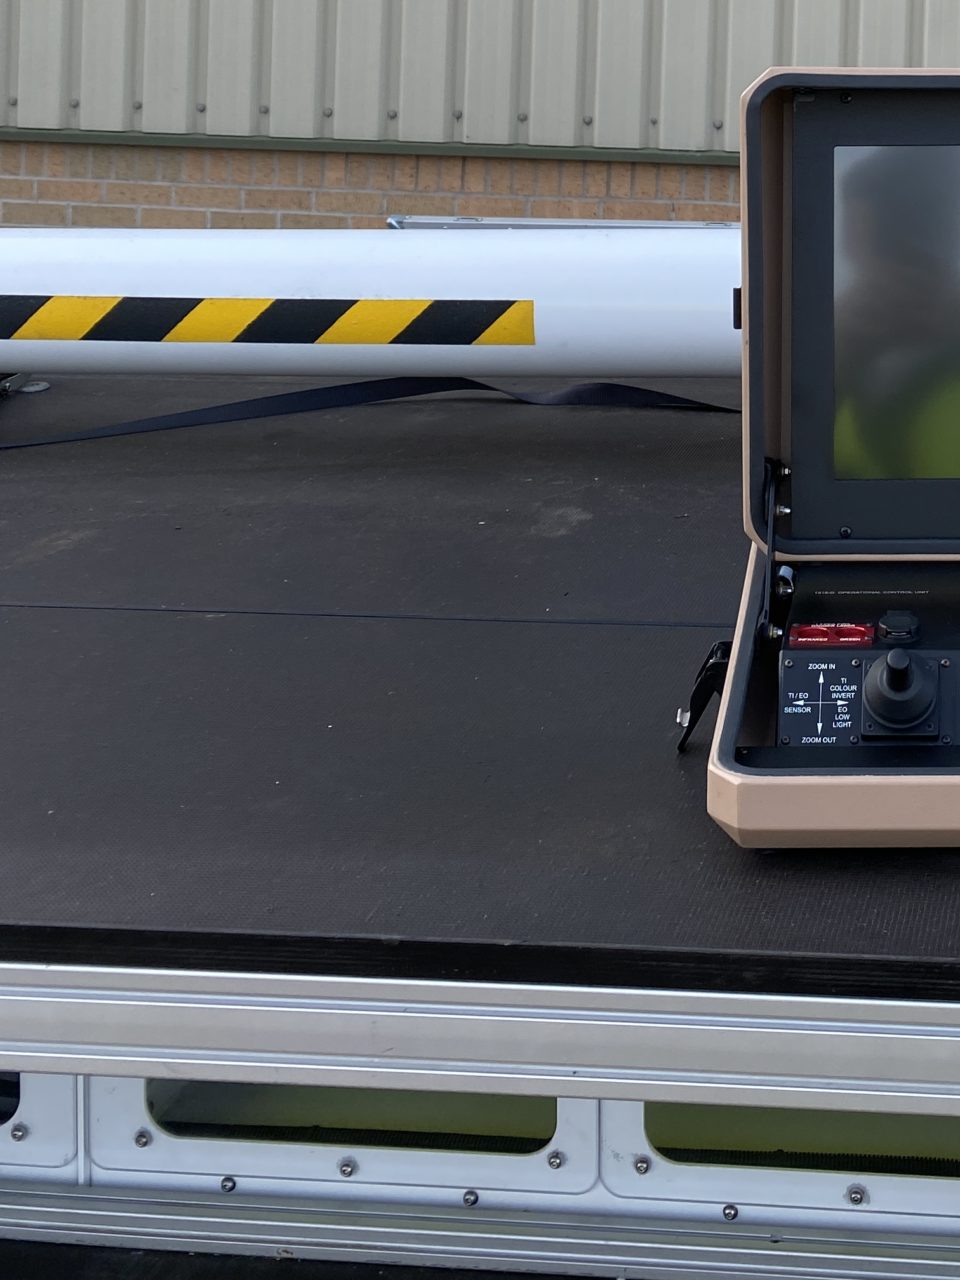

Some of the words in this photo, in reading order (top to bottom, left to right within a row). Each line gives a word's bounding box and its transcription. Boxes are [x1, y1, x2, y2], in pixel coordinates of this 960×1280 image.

[829, 684, 858, 692] COLOUR
[834, 713, 851, 721] LOW
[801, 736, 822, 744] ZOOM
[822, 736, 837, 744] OUT
